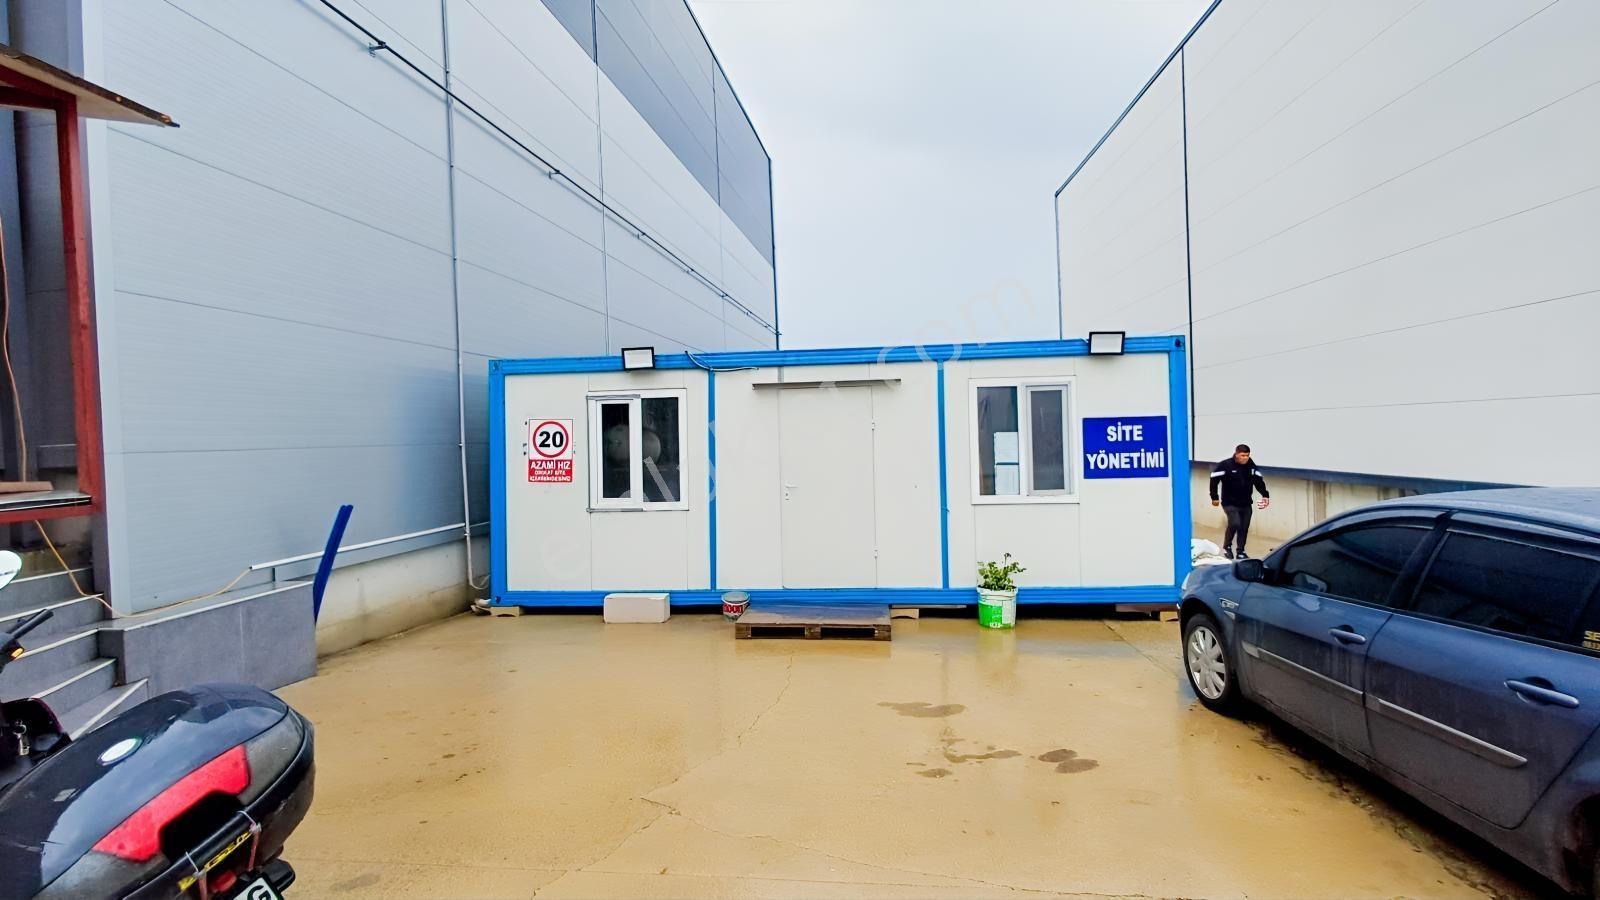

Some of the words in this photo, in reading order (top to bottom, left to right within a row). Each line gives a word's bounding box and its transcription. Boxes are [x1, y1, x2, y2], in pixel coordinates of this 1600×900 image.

[538, 431, 564, 448] 20
[1107, 421, 1143, 442] SİTE
[1085, 447, 1165, 470] YÖNETİMİ
